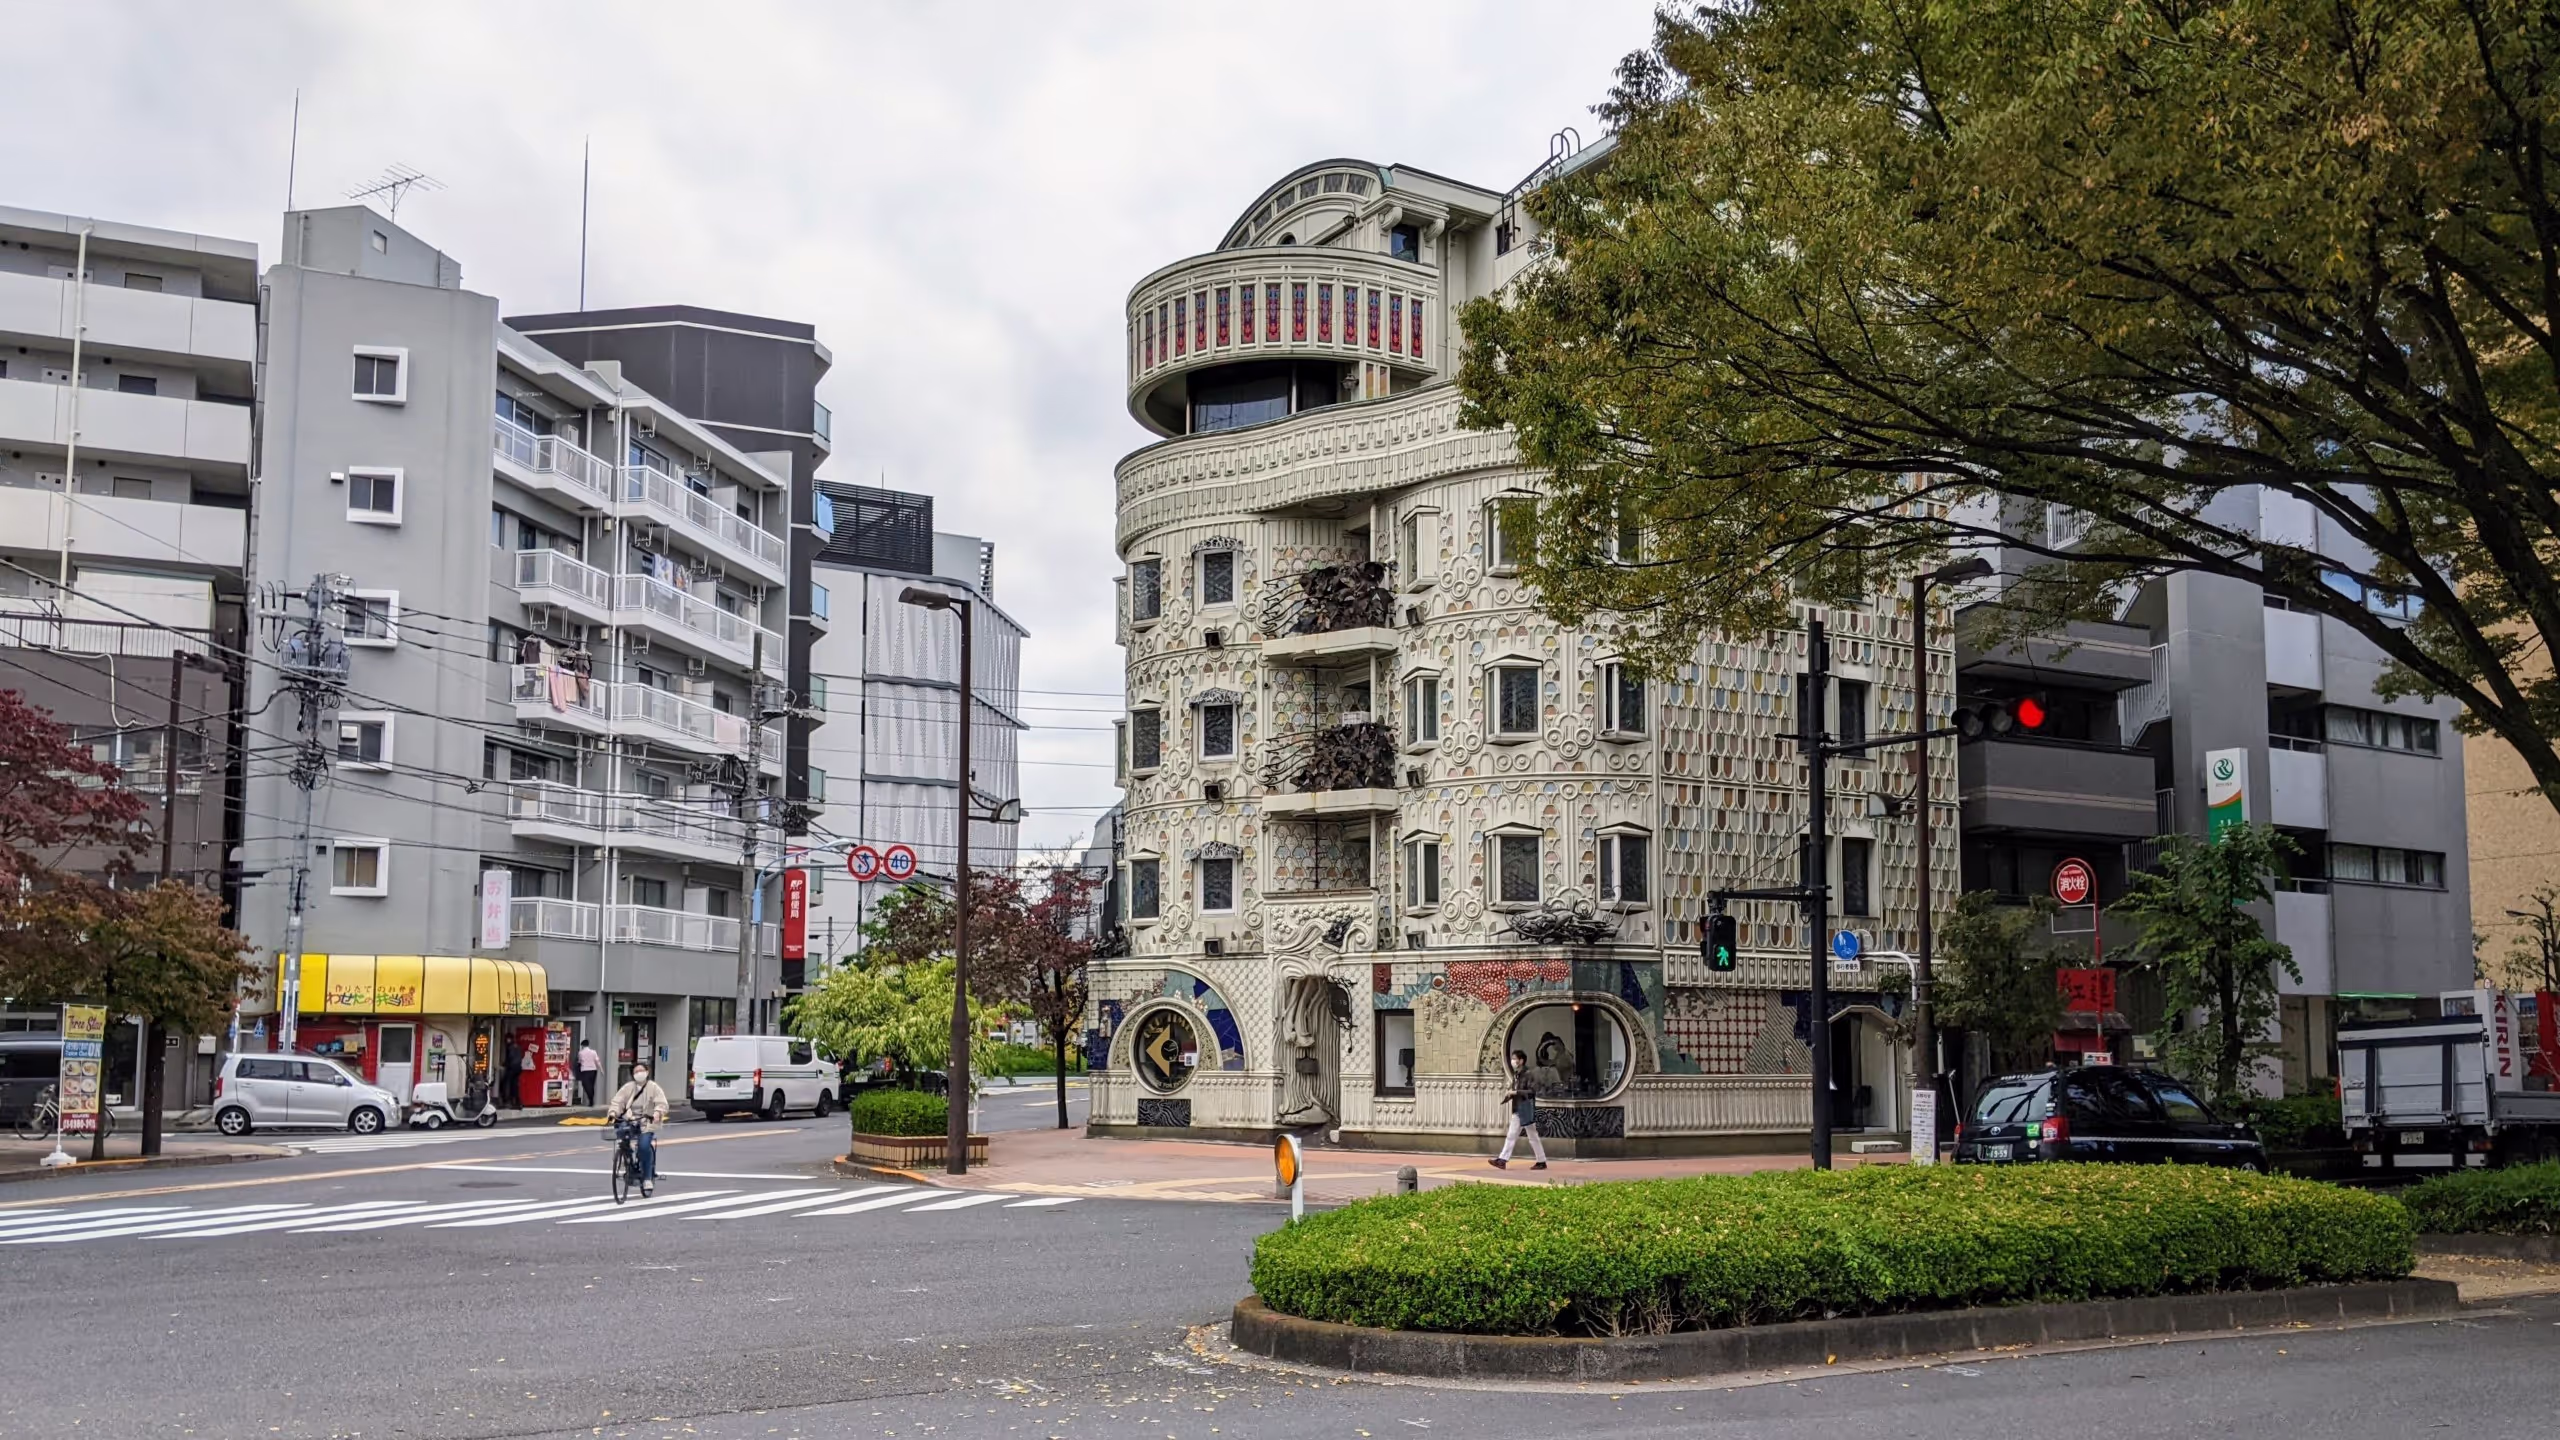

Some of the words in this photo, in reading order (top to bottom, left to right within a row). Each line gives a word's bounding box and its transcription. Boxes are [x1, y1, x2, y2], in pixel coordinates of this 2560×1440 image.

[891, 854, 909, 870] 40
[2060, 875, 2086, 892] 消火栓
[790, 891, 801, 920] 郵便局
[2494, 994, 2512, 1078] KIRIN
